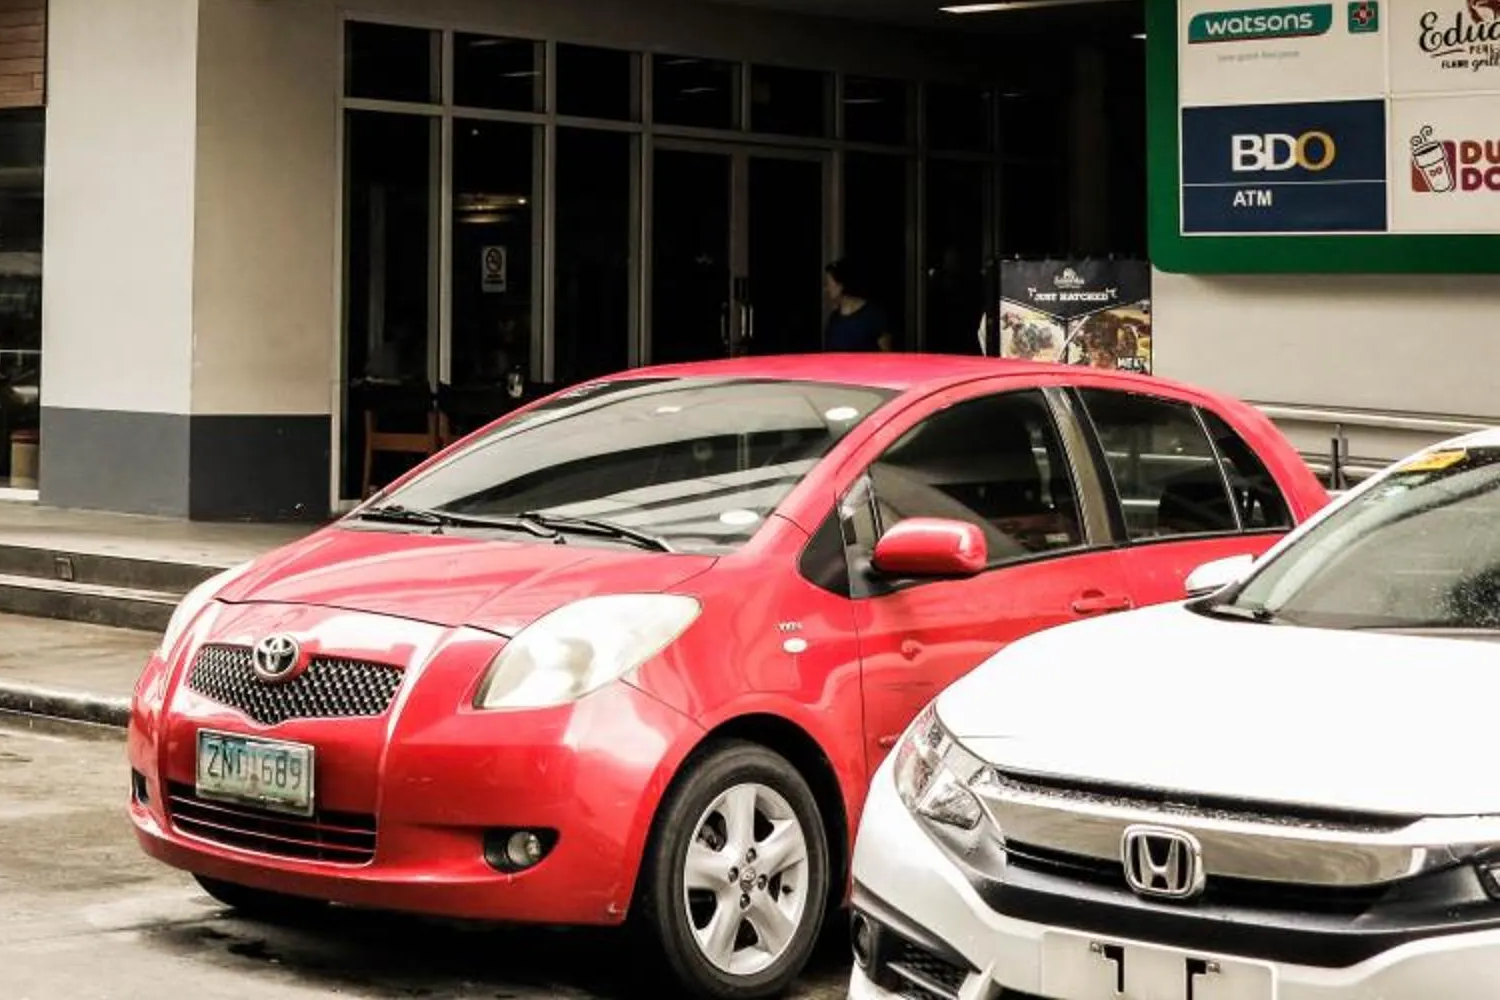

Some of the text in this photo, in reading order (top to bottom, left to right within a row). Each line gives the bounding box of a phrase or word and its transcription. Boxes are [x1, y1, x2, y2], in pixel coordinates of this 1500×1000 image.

[1205, 12, 1313, 35] watsons
[1231, 131, 1335, 171] BDO
[1233, 189, 1273, 207] ATM
[261, 752, 302, 790] 689
